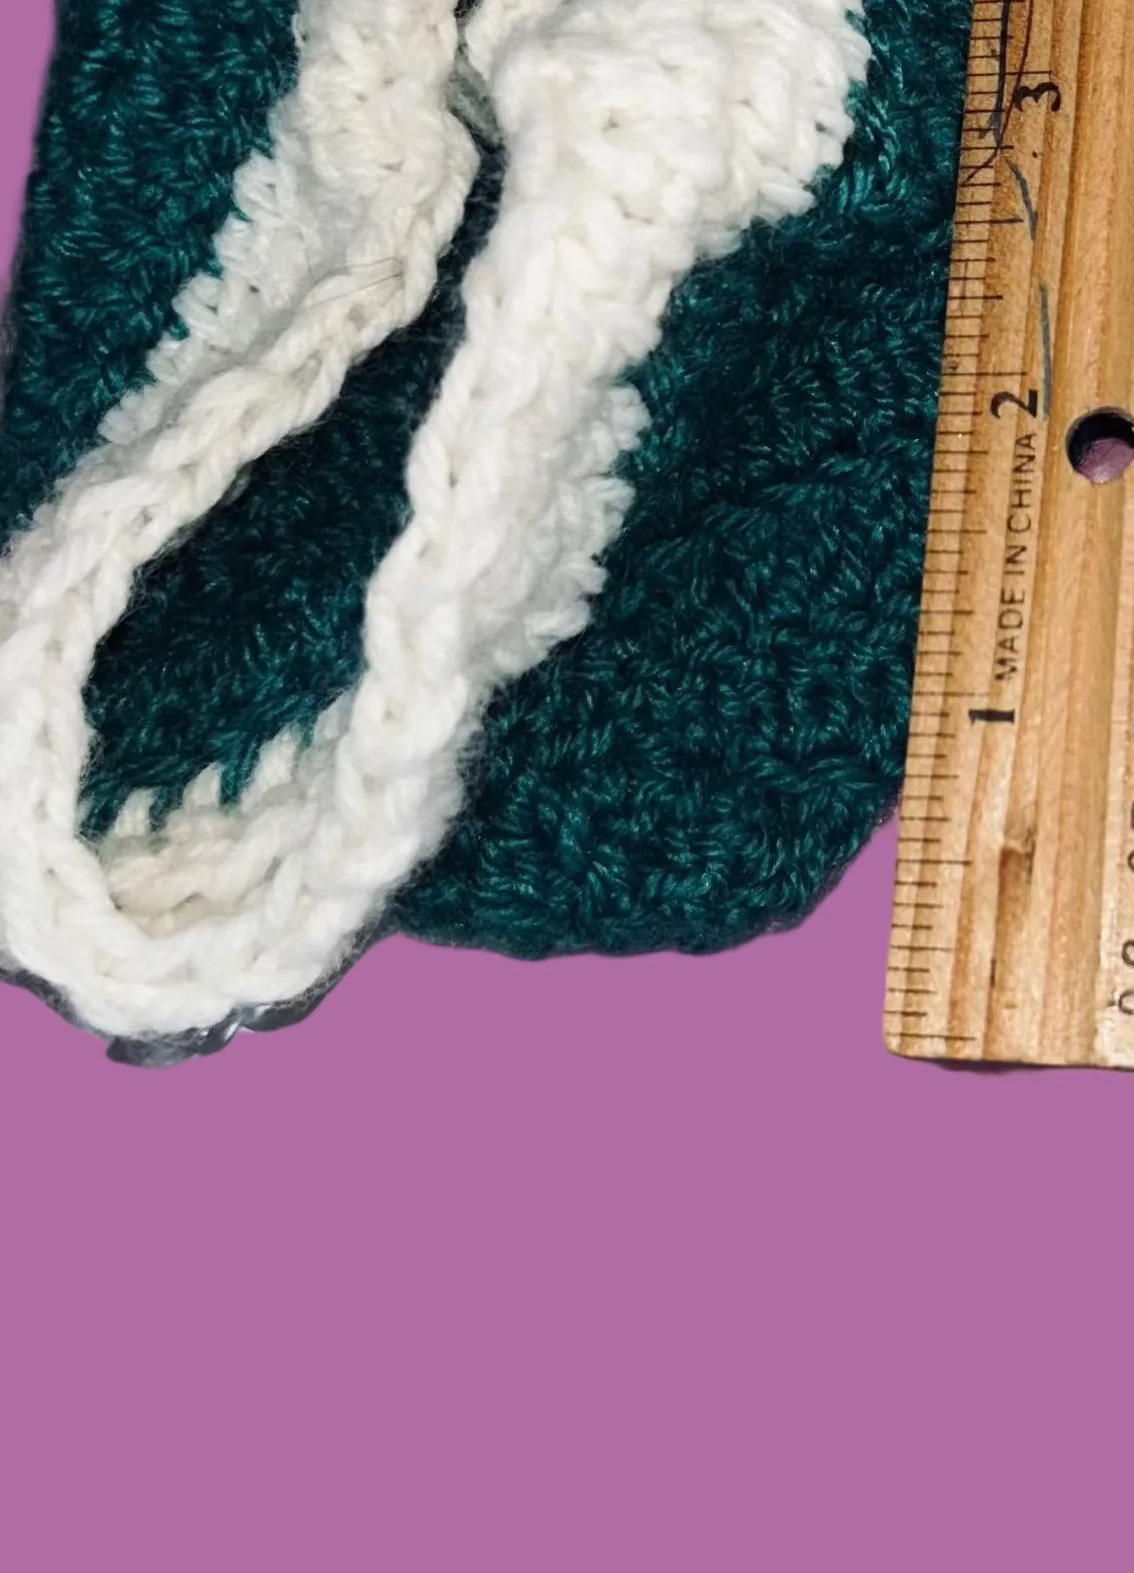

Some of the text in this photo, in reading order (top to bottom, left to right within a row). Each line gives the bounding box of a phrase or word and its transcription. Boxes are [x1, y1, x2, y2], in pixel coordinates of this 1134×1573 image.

[1013, 82, 1062, 113] 3
[990, 389, 1039, 419] 2
[994, 432, 1037, 681] MADE IN CHINA
[967, 708, 1015, 726] 1
